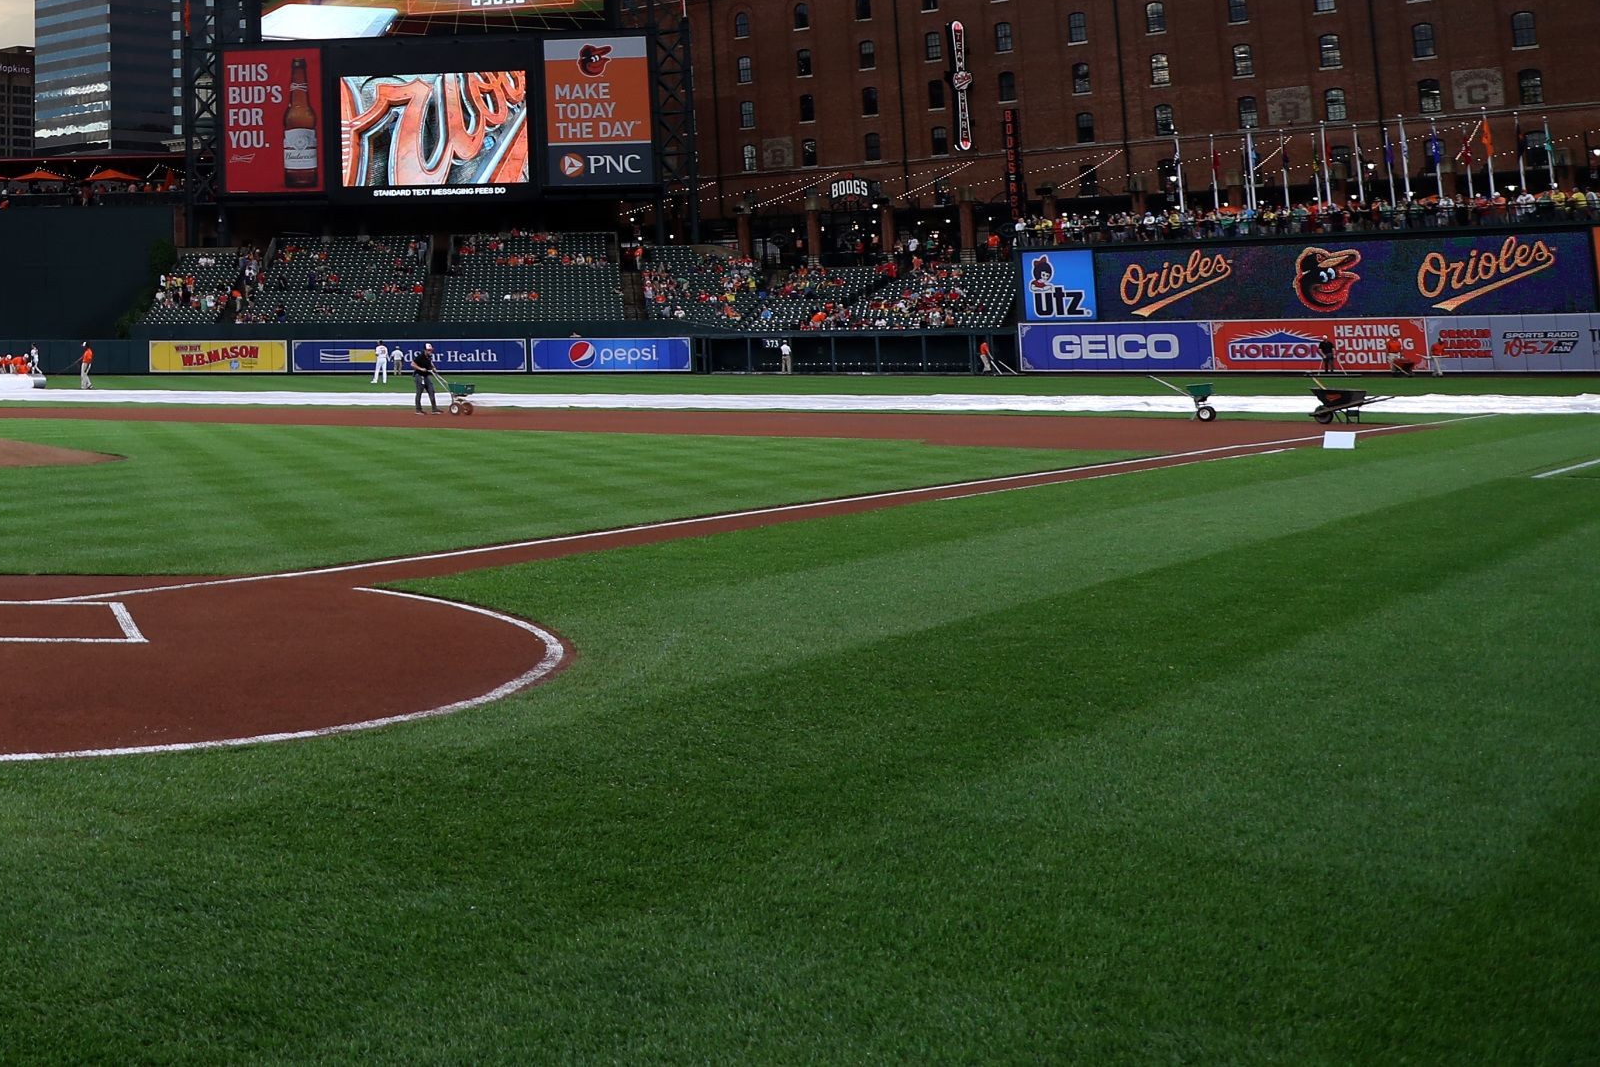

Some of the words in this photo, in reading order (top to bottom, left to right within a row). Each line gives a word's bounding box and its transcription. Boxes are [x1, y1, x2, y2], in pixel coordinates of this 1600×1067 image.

[227, 63, 269, 82] THIS
[228, 85, 283, 104] BUD'S
[554, 82, 611, 100] MAKE
[229, 108, 264, 126] FOR
[554, 102, 617, 119] TODAY
[229, 130, 270, 148] YOU.
[556, 122, 594, 139] THE
[599, 121, 635, 138] DAY
[587, 154, 642, 174] PNC
[373, 189, 411, 197] STANDARD
[1417, 236, 1555, 297] Orioles
[1120, 248, 1230, 306] Orioles
[1333, 324, 1400, 338] HEATING
[1589, 329, 1600, 342] T
[765, 339, 779, 348] 373
[1052, 334, 1180, 359] GEICO
[1335, 338, 1414, 351] PLUMBG
[447, 349, 498, 362] Health
[600, 345, 656, 364] pepsi
[1339, 352, 1388, 364] COOLI
